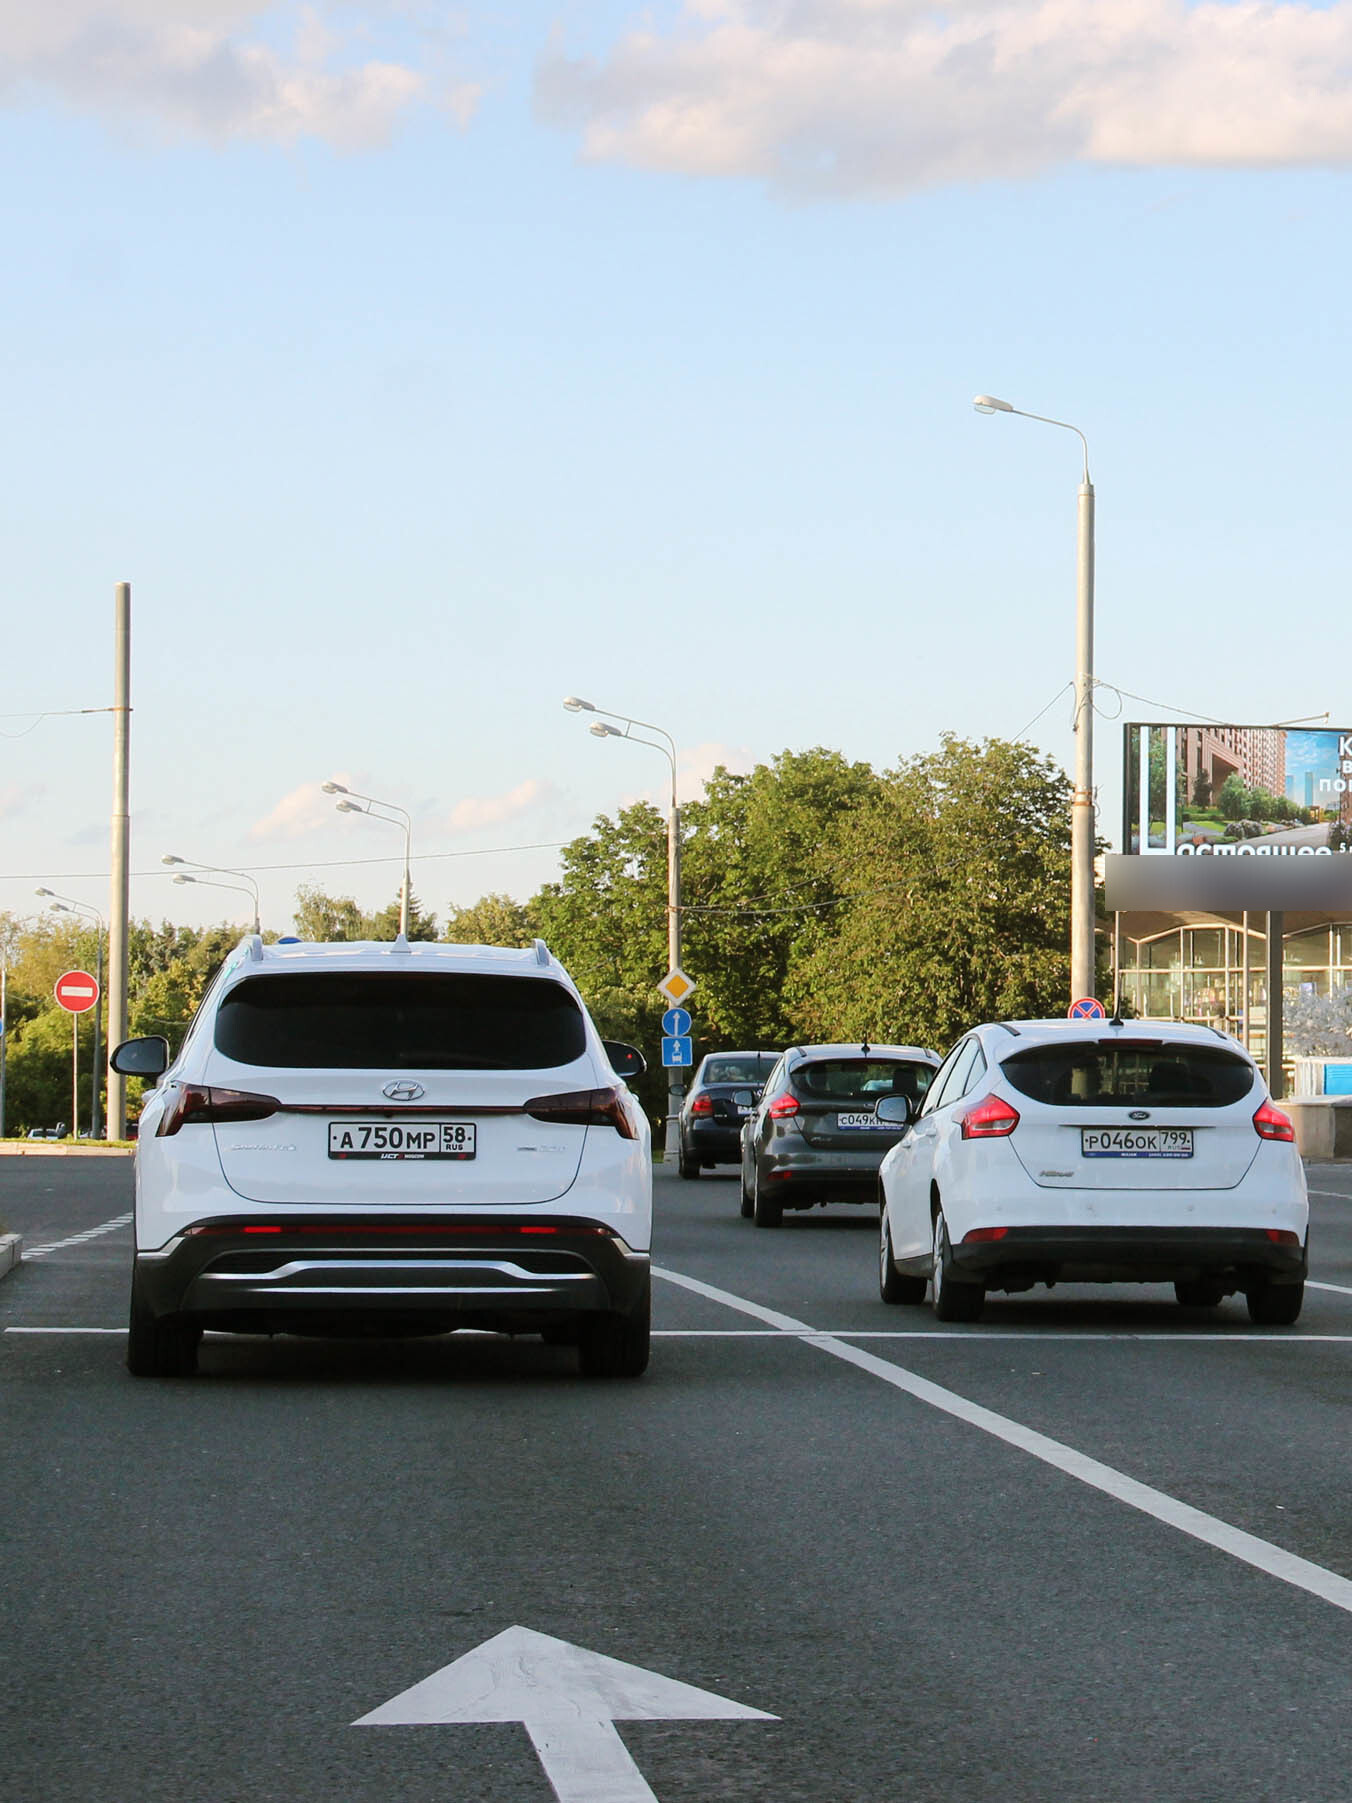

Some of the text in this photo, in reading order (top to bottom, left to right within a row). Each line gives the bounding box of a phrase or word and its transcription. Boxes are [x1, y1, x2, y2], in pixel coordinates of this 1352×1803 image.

[1340, 842, 1347, 853] 5
[340, 1127, 466, 1149] А750МР 58
[1089, 1131, 1188, 1149] Р046ОК 799
